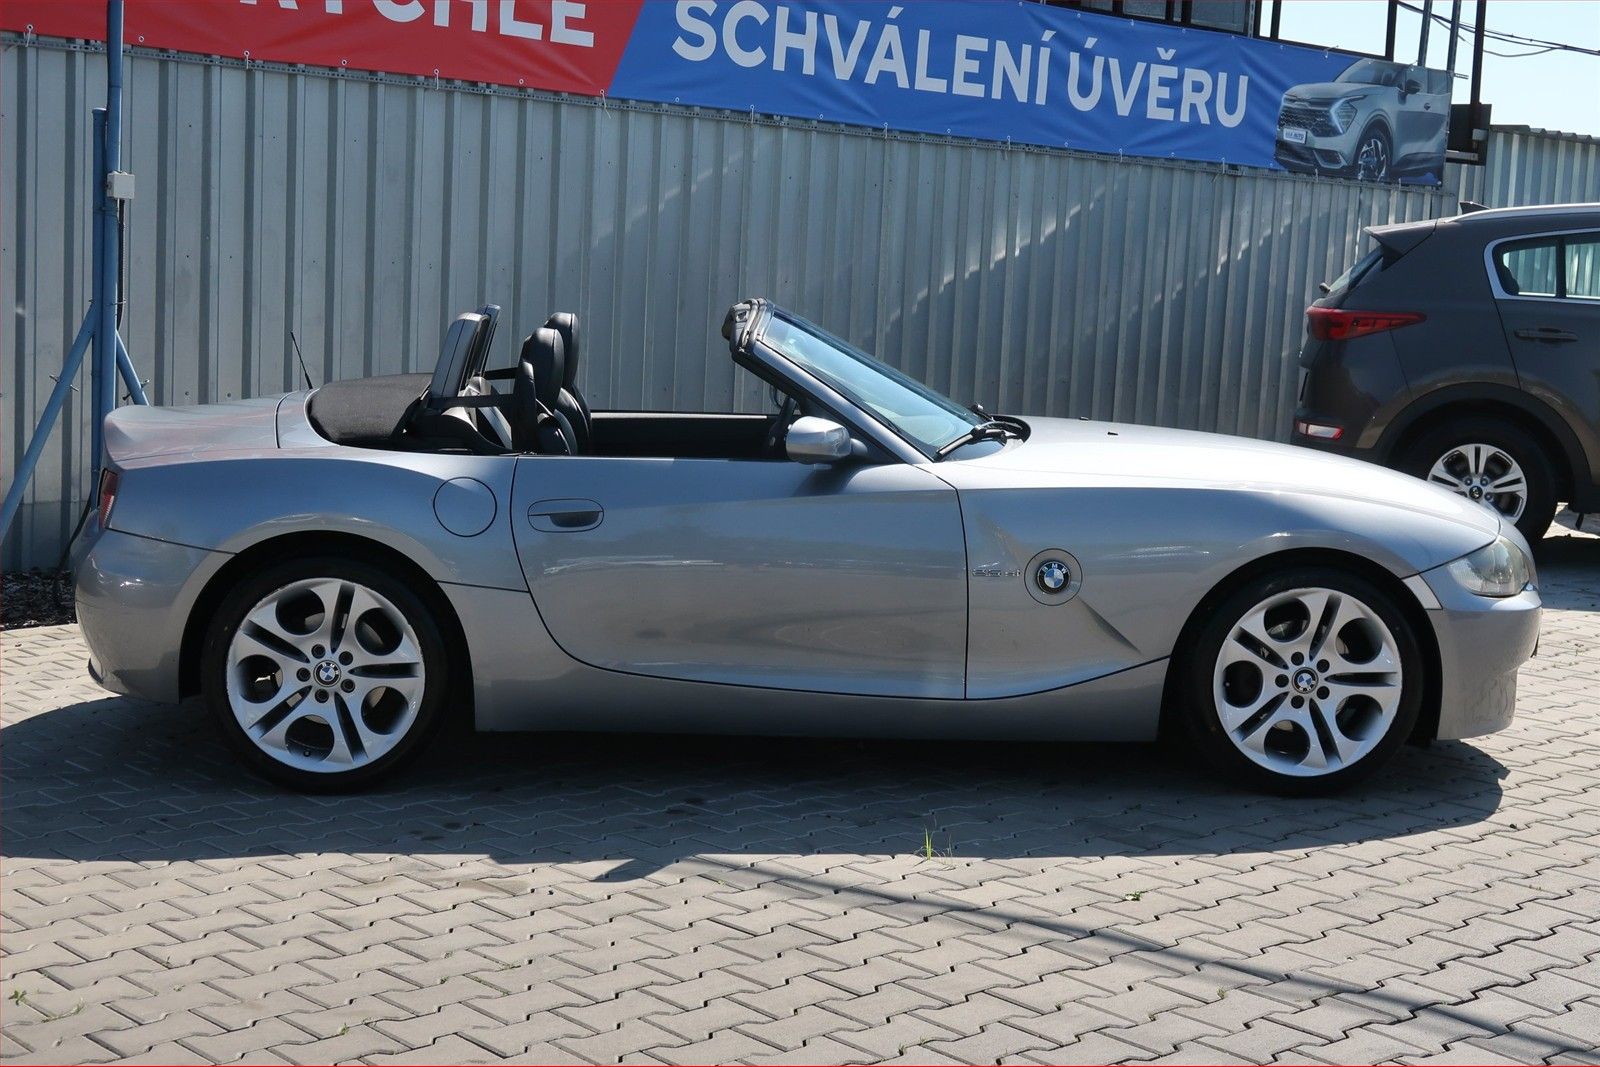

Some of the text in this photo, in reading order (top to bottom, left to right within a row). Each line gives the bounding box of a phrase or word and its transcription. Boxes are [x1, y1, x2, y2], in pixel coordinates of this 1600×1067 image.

[238, 0, 595, 48] HLE
[672, 0, 1249, 128] SCHVÁLENÍ ÚVĚRU
